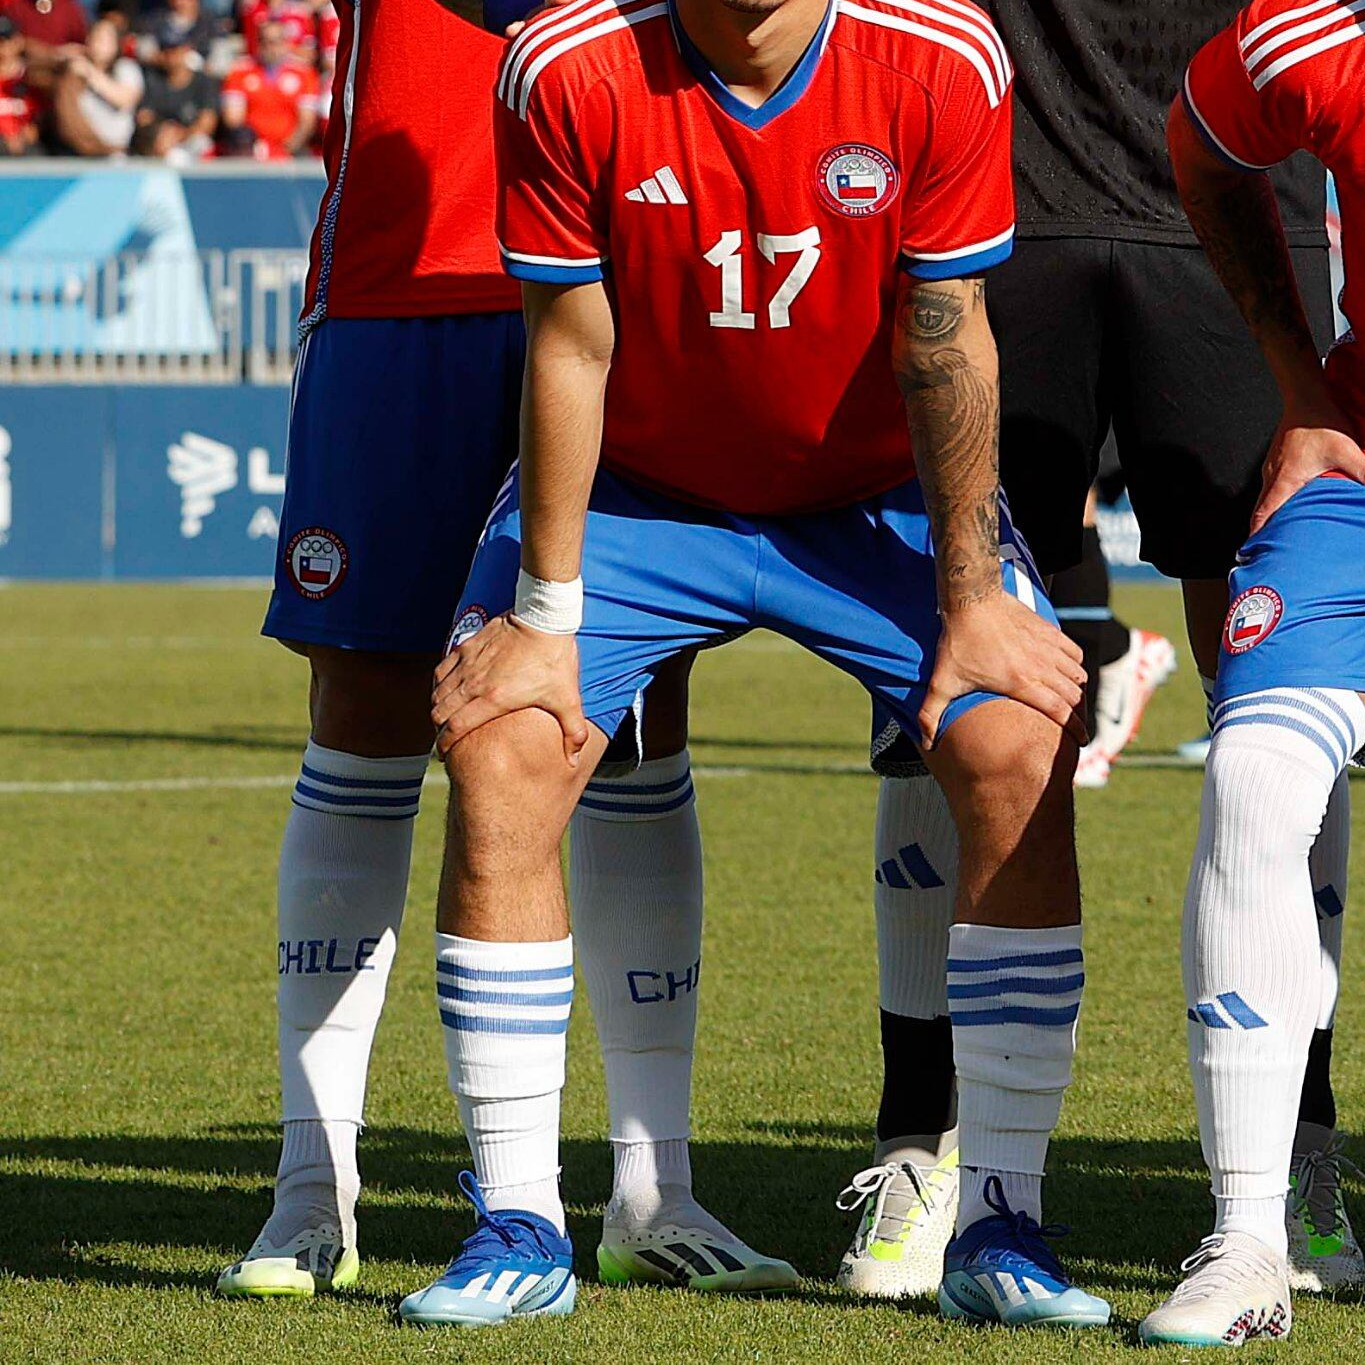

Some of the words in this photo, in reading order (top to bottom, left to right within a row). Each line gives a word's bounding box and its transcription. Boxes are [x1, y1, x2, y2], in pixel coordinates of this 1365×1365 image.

[820, 148, 846, 174] COMITE
[850, 147, 890, 174] OLIMPICO
[841, 204, 876, 215] CHILE
[703, 225, 821, 329] 17
[279, 938, 382, 975] CHILE
